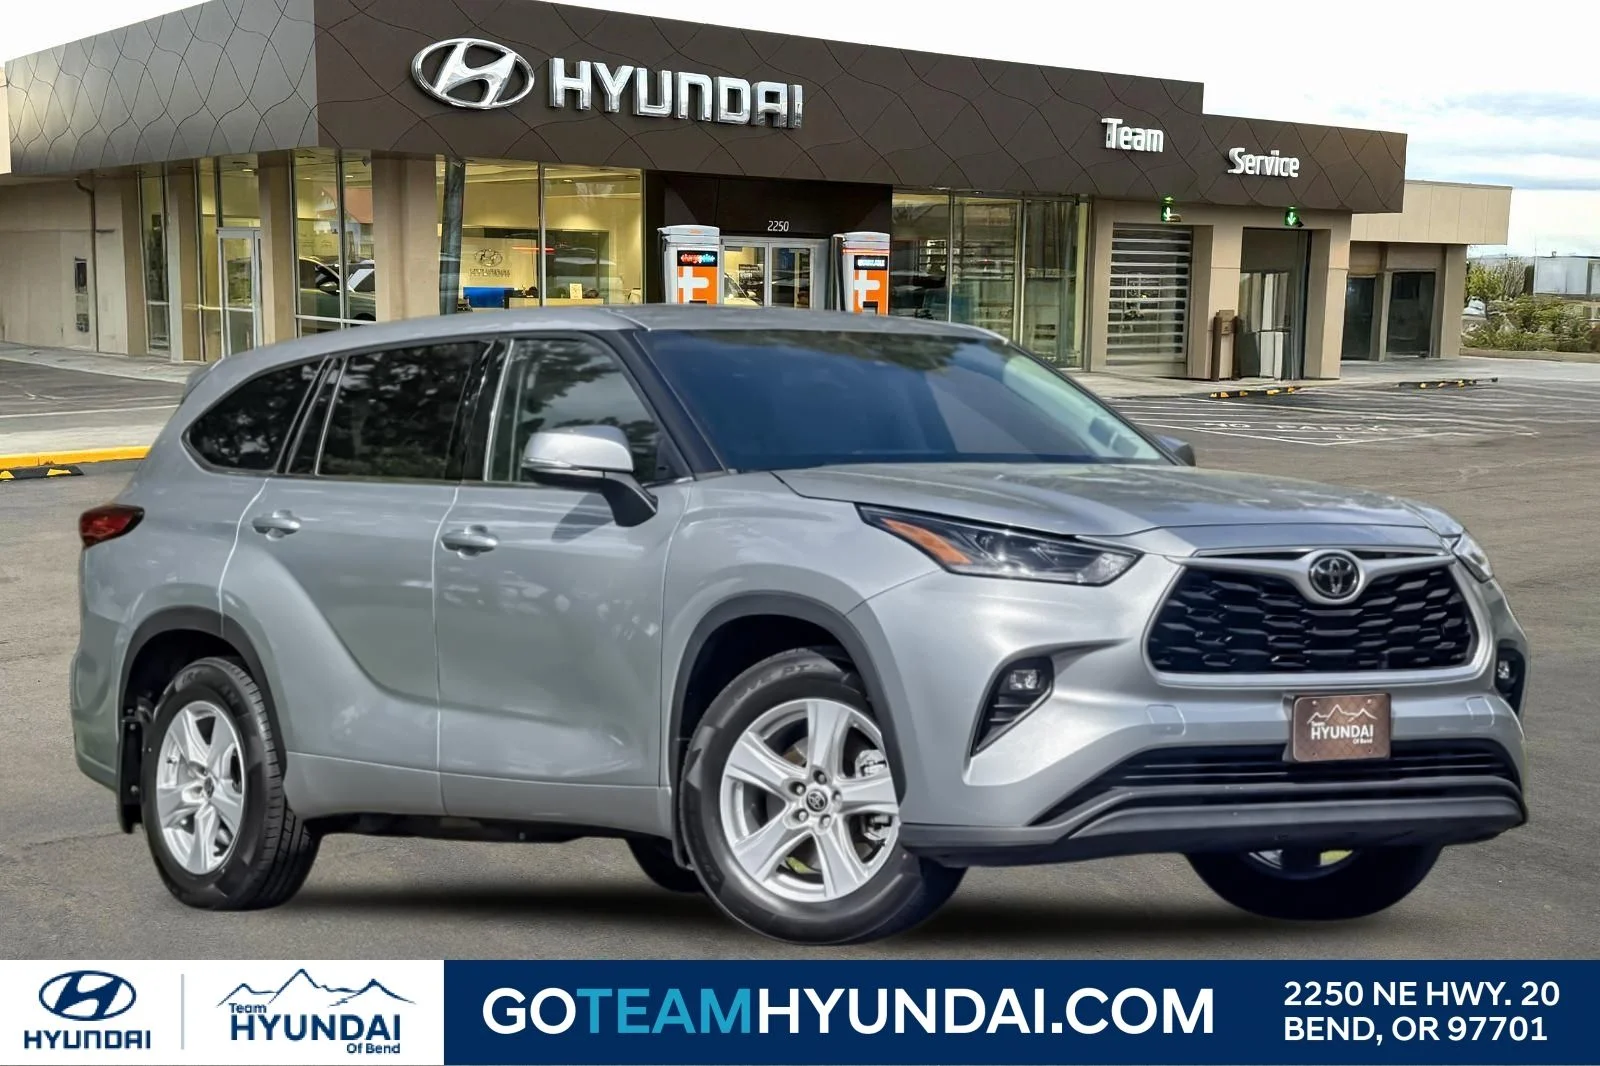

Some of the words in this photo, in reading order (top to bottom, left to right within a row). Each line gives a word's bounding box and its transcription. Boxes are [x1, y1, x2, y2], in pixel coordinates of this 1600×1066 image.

[548, 57, 803, 129] HYUNDAI
[1101, 117, 1164, 152] Team
[1227, 147, 1300, 178] Service
[767, 220, 790, 232] 2250
[1311, 724, 1374, 740] HYUNDAI
